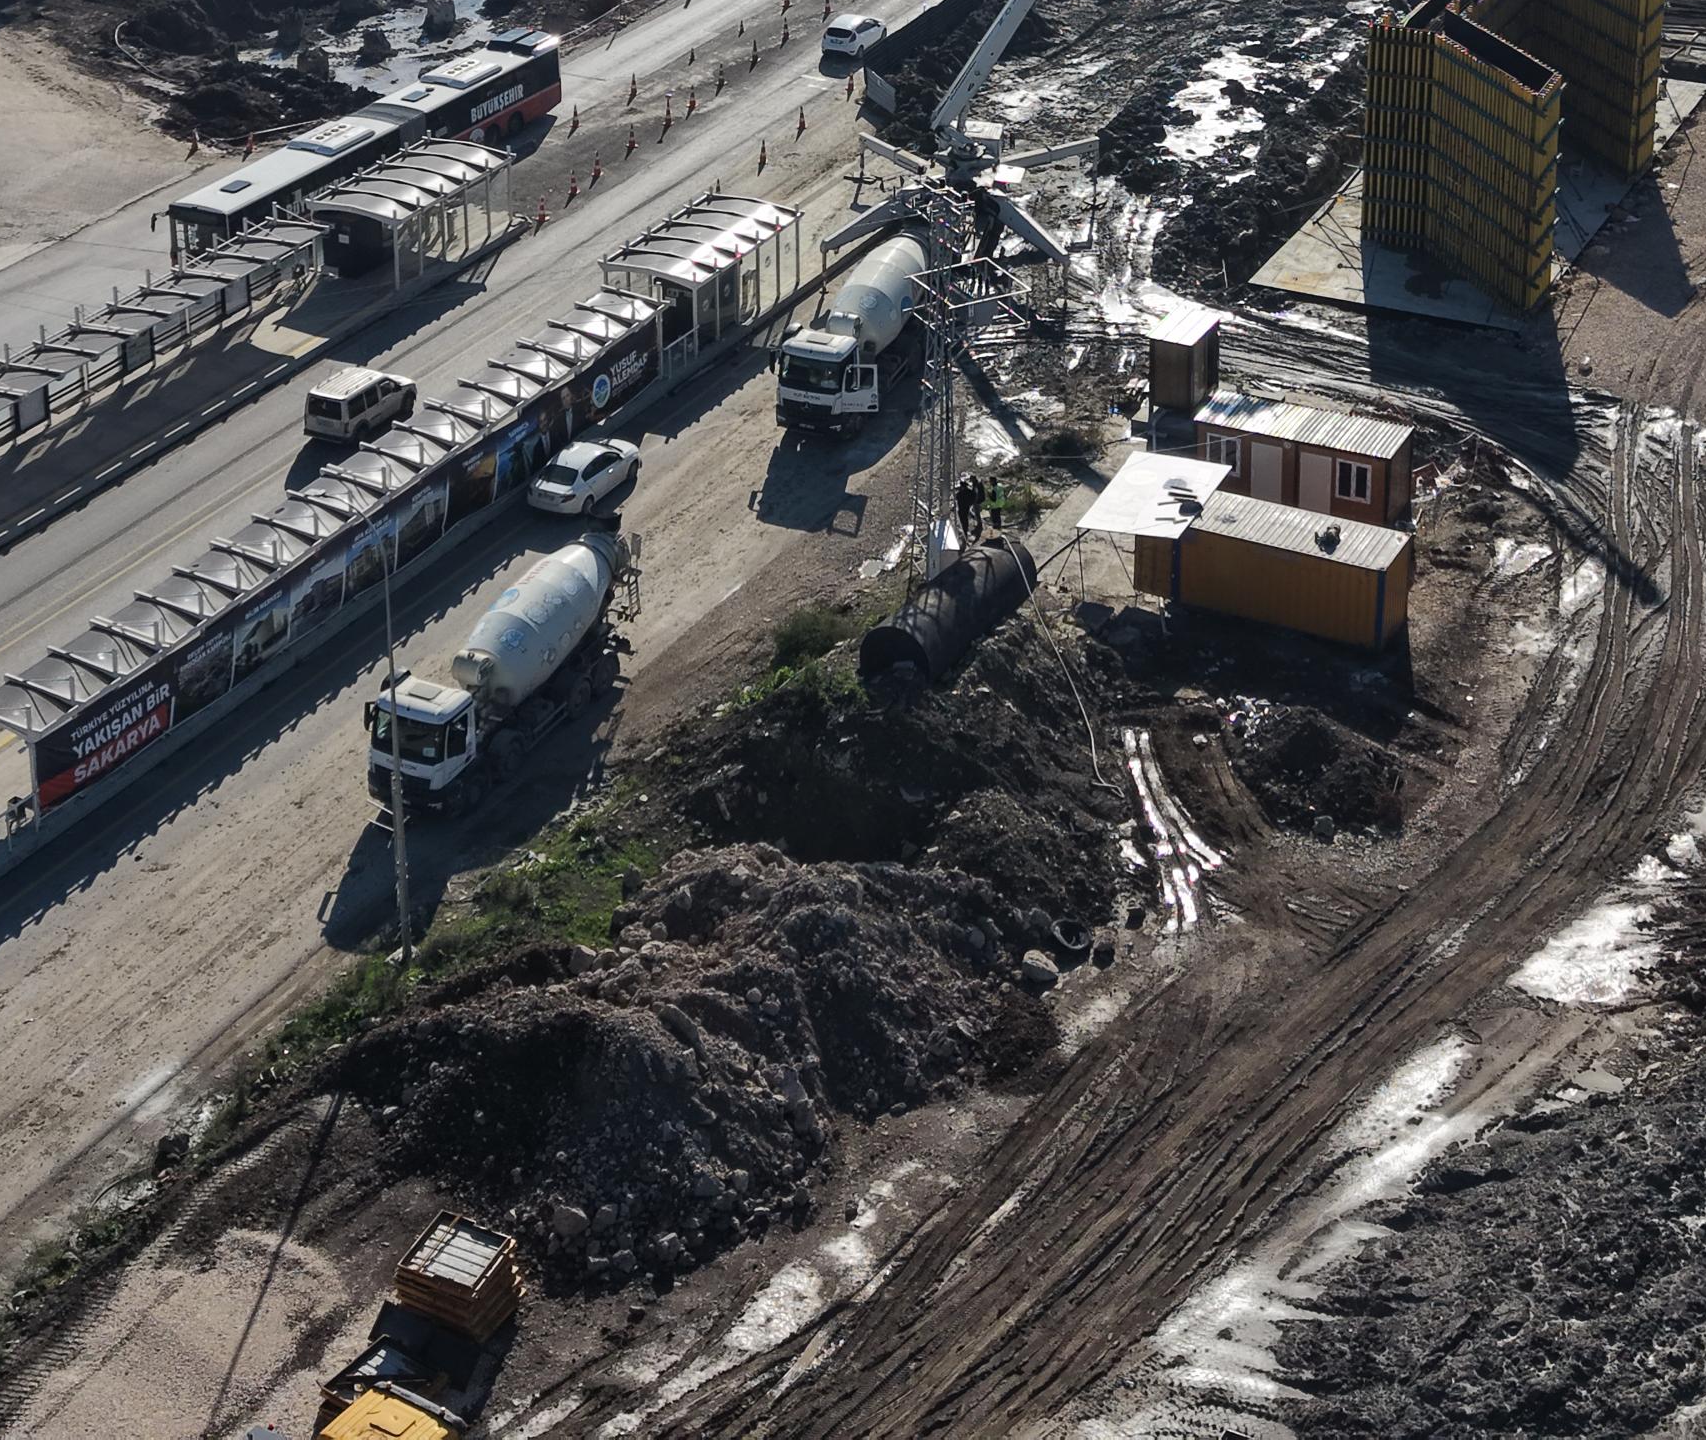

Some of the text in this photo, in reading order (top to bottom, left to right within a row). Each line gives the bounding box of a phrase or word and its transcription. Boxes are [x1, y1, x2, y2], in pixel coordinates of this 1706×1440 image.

[70, 712, 109, 742] TÜRKİYE
[72, 683, 171, 759] YAKIŞAN BİR
[73, 714, 161, 784] SAKARYA
